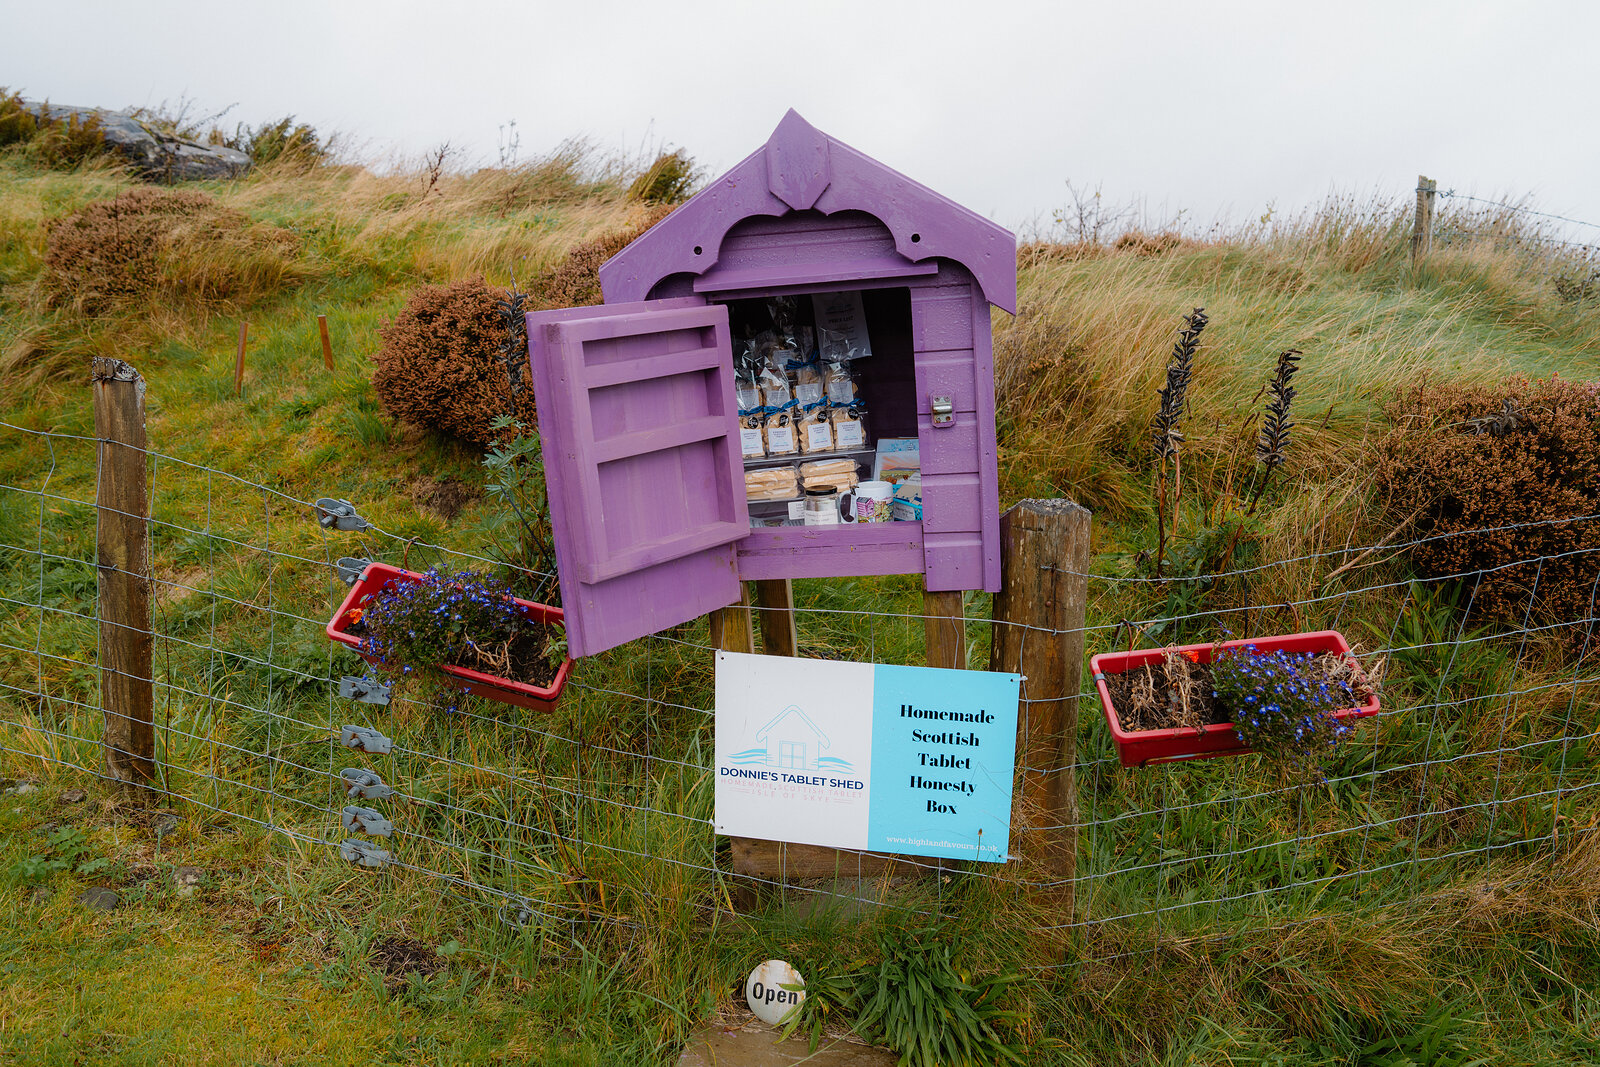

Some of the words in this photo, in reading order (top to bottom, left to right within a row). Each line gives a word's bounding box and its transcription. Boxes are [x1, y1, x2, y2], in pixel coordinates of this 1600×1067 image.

[900, 704, 995, 724] Homemade
[912, 729, 980, 747] Scottish
[917, 752, 972, 770] Tablet
[720, 767, 779, 782] DONNIE'S
[780, 773, 828, 787] TABLET
[829, 778, 864, 790] SHED
[720, 778, 777, 790] HOMEMADE
[777, 784, 824, 794] SCOTTISH
[828, 789, 863, 798] TABLET
[910, 775, 977, 797] Honesty
[751, 789, 776, 798] ISLE
[803, 794, 829, 803] SKYE
[926, 799, 958, 815] Box
[886, 835, 999, 852] www.highlandfavours.co.uk
[752, 982, 798, 1005] Open
